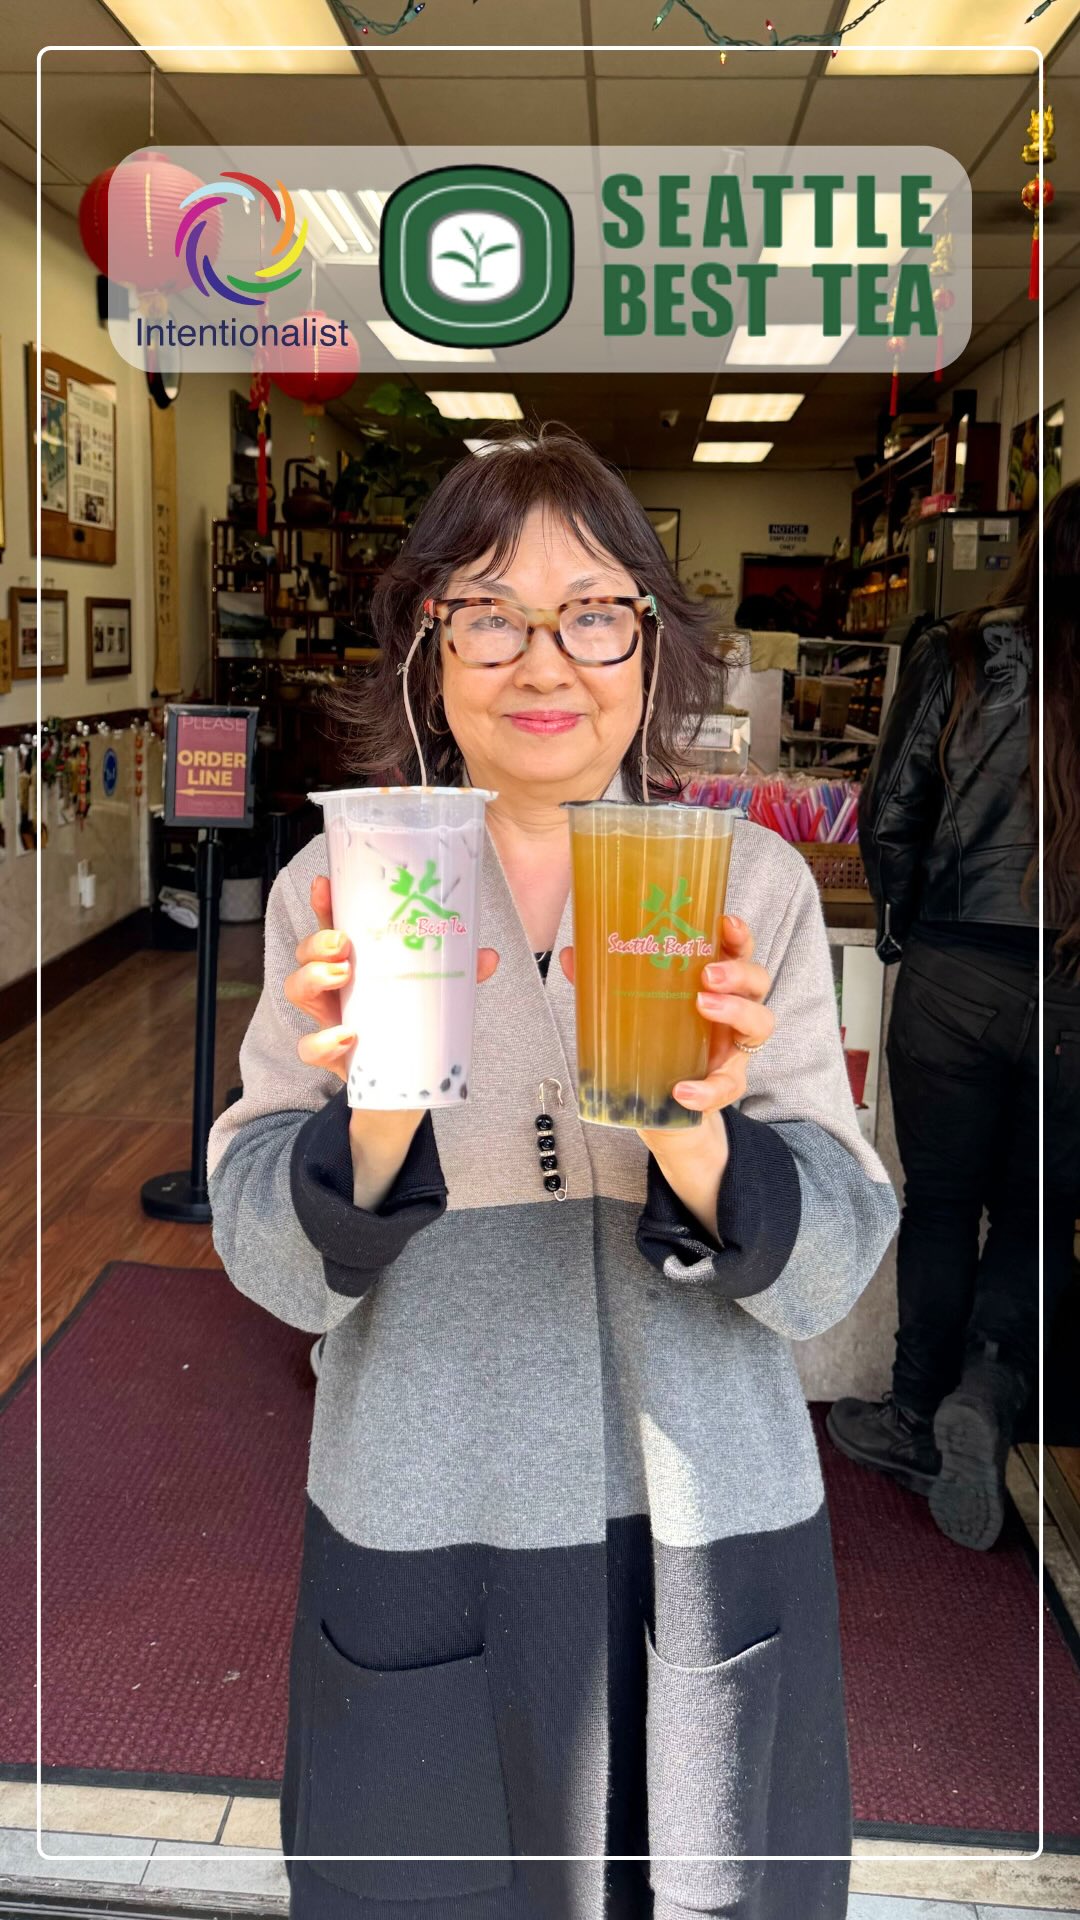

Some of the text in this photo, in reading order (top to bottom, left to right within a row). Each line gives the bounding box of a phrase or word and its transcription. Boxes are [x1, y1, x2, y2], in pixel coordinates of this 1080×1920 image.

[182, 716, 246, 731] PLEASE
[177, 749, 247, 768] ORDER
[187, 769, 233, 786] LINE
[415, 917, 449, 936] Best
[608, 932, 713, 956] Seattle Best Tea
